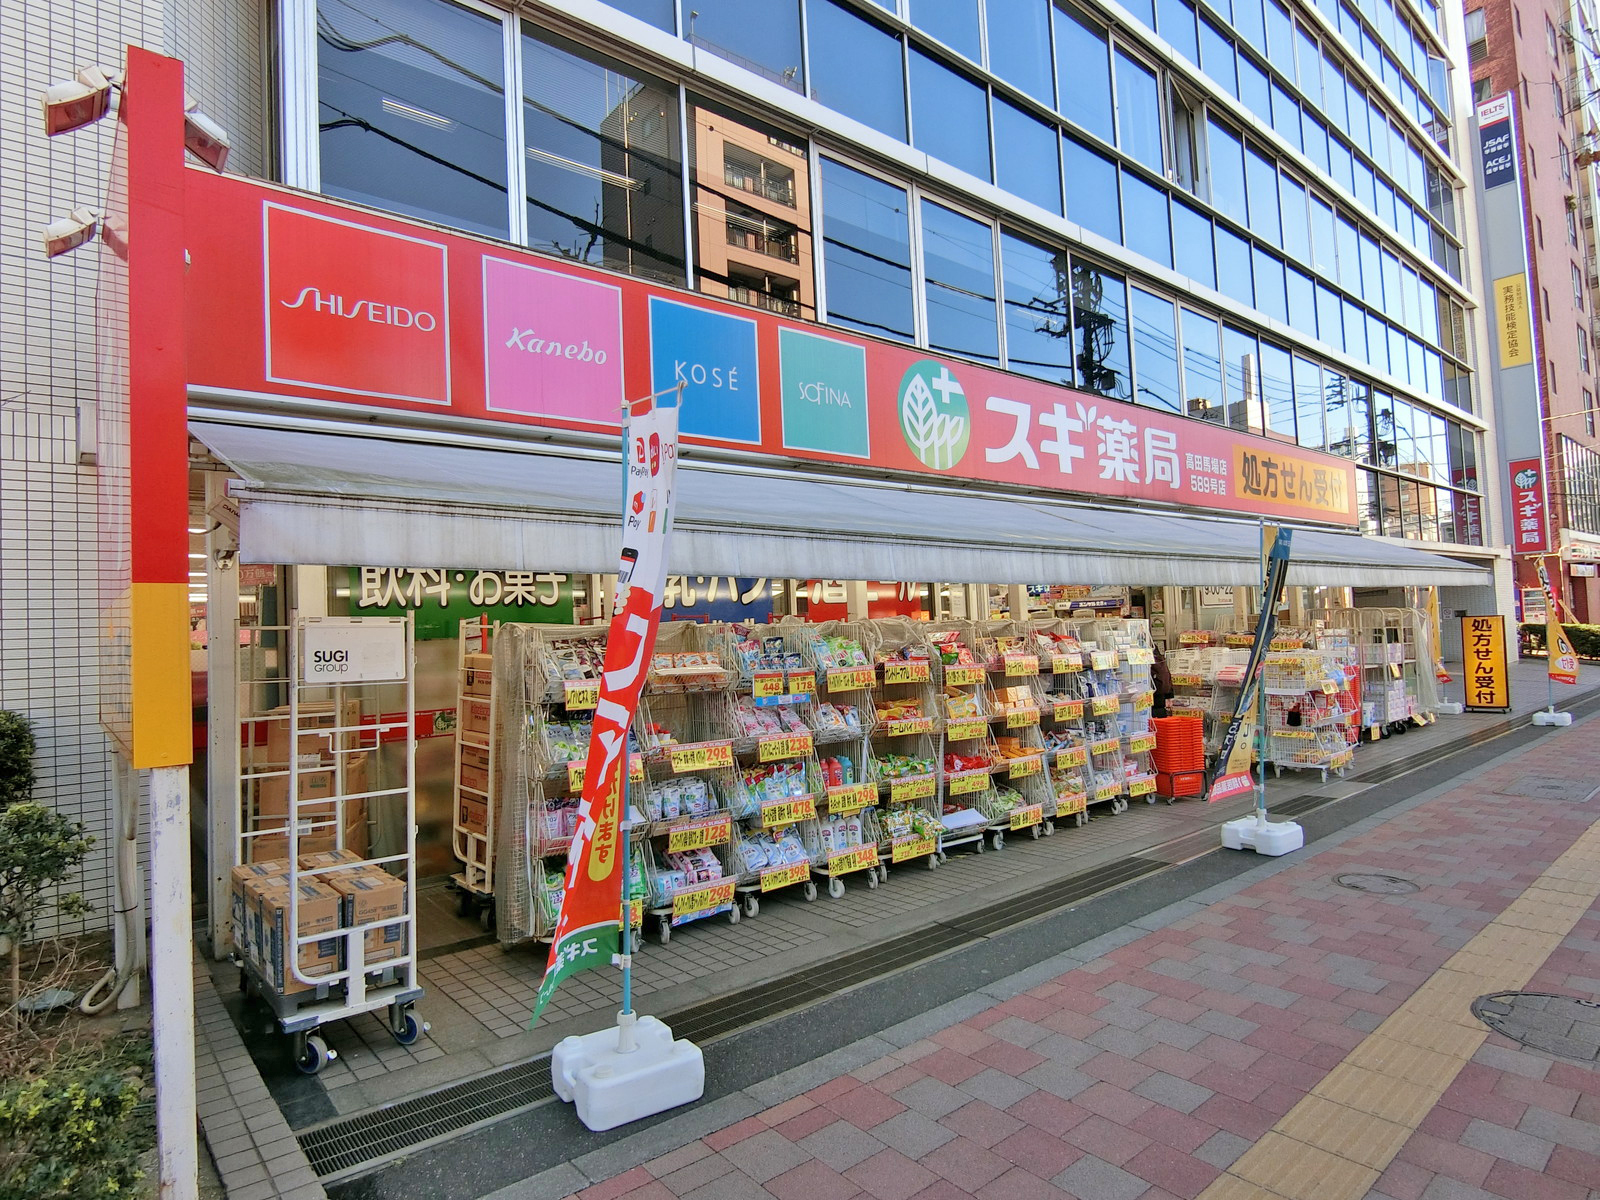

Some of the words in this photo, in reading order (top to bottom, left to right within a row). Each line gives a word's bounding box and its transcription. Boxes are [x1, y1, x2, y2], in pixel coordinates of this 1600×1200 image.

[1481, 103, 1505, 117] IELTS
[1483, 134, 1510, 150] JSAF
[1485, 154, 1511, 169] ACEJ
[281, 287, 437, 333] SHISEIDO
[1502, 285, 1520, 358] 実務技能検定協会
[505, 327, 608, 366] Kanebo
[674, 359, 739, 391] KOSÉ
[798, 382, 852, 409] SOFINA
[984, 396, 1181, 490] スギ薬局
[630, 465, 649, 478] PayPay
[1185, 452, 1228, 477] 高田馬場店
[1241, 450, 1343, 509] 処方せん受付
[628, 515, 641, 531] Pay
[1518, 490, 1542, 545] スギ薬局
[314, 650, 349, 663] SUGI
[1471, 618, 1496, 705] 処方せん受付
[855, 671, 873, 683] 438
[909, 666, 926, 678] 198
[762, 681, 780, 692] 448
[795, 680, 813, 691] 178
[789, 737, 810, 752] 238
[705, 748, 728, 761] 298
[856, 789, 875, 804] 298
[792, 801, 811, 815] 478
[704, 824, 727, 841] 128
[856, 848, 874, 864] 348
[789, 865, 805, 879] 398
[709, 884, 731, 903] 298
